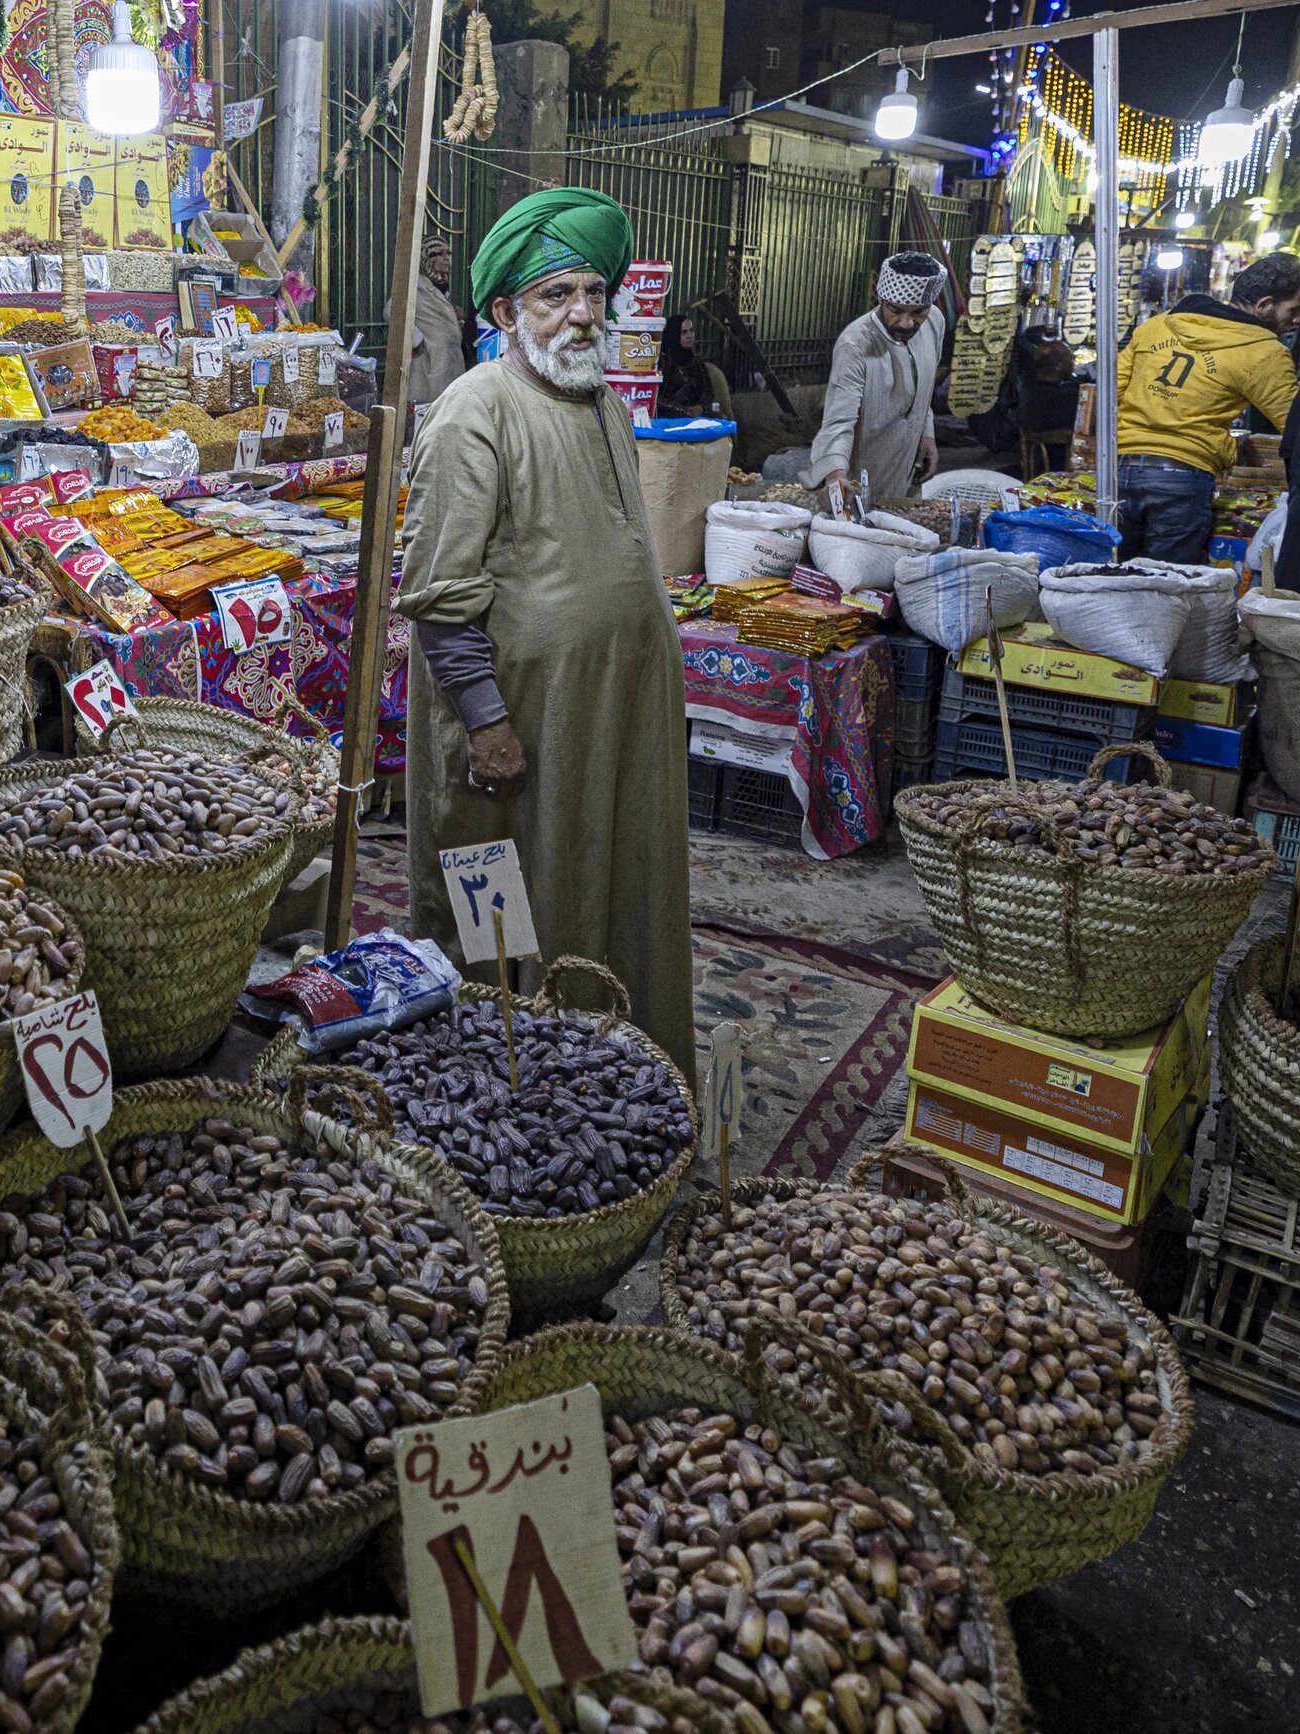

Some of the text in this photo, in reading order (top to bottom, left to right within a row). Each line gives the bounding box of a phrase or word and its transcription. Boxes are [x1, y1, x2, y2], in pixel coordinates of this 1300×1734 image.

[1154, 350, 1195, 389] D
[270, 415, 282, 438] ٩٠
[328, 419, 340, 437] ٧٠
[228, 597, 283, 649] ١٥
[1050, 659, 1076, 670] تمور
[73, 679, 126, 731] ٢٠
[482, 843, 506, 866] بلح
[458, 873, 505, 928] ٣٠
[64, 993, 96, 1031] بلح
[22, 1033, 110, 1130] ٢٥
[427, 1514, 605, 1708] ١٨
